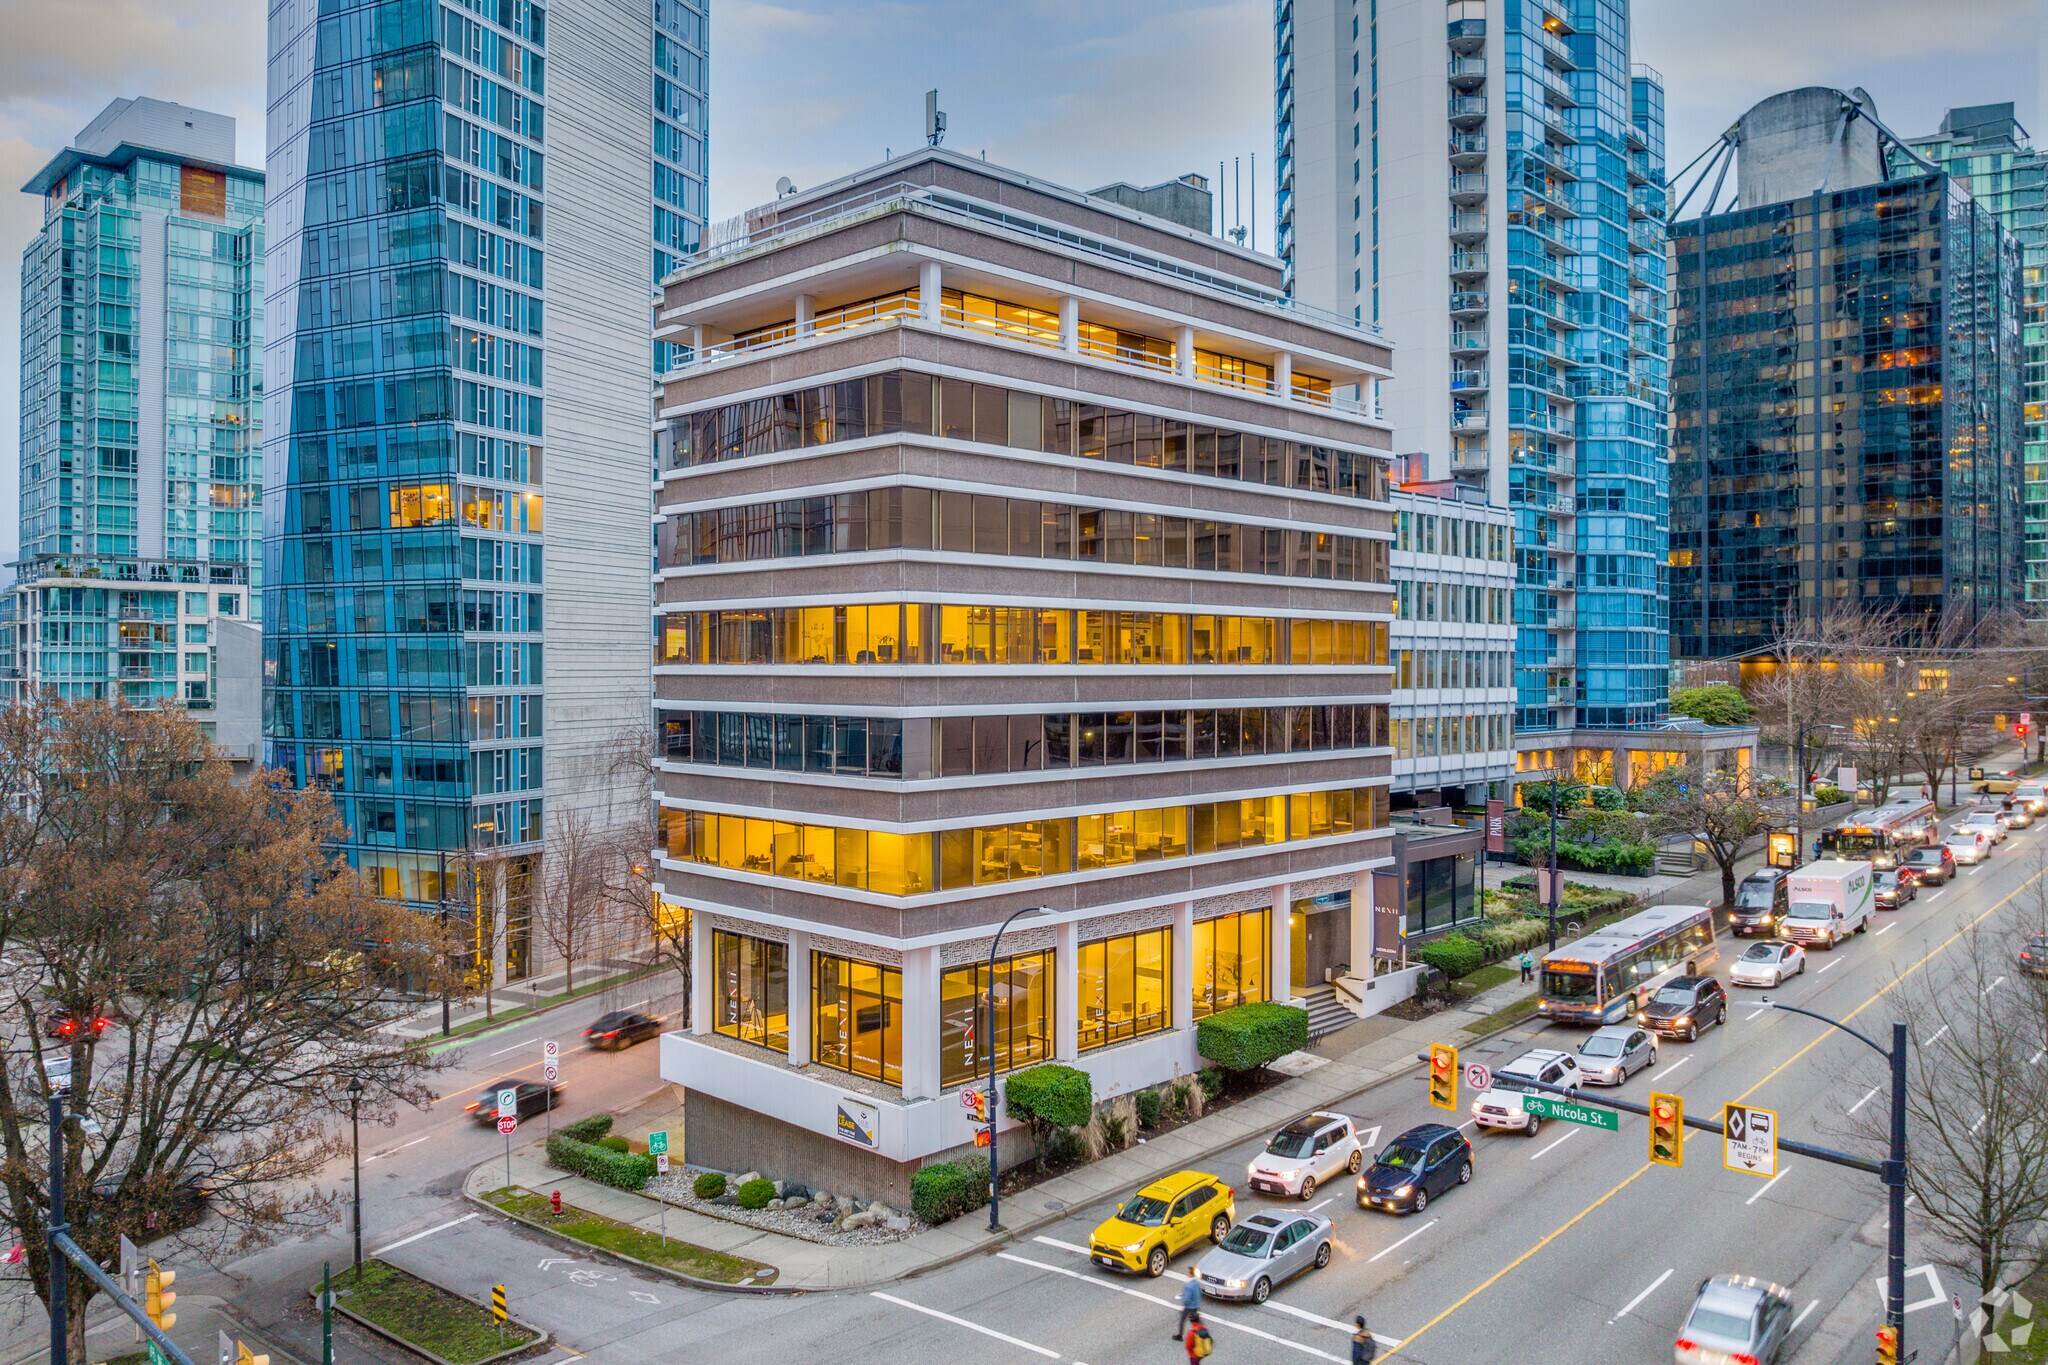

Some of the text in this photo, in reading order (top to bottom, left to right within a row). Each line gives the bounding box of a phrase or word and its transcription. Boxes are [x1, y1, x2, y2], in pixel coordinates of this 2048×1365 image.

[1490, 816, 1502, 836] PARK
[1375, 906, 1398, 914] NEXII
[729, 972, 737, 1023] NEXII
[1096, 979, 1104, 1032] NEXII
[839, 1000, 847, 1055] NEXII
[964, 1008, 974, 1066] NEXII
[499, 1120, 515, 1129] STOP
[838, 1118, 855, 1130] LEASE
[1552, 1104, 1607, 1126] Nicola St.
[1738, 1152, 1761, 1161] BEGINS
